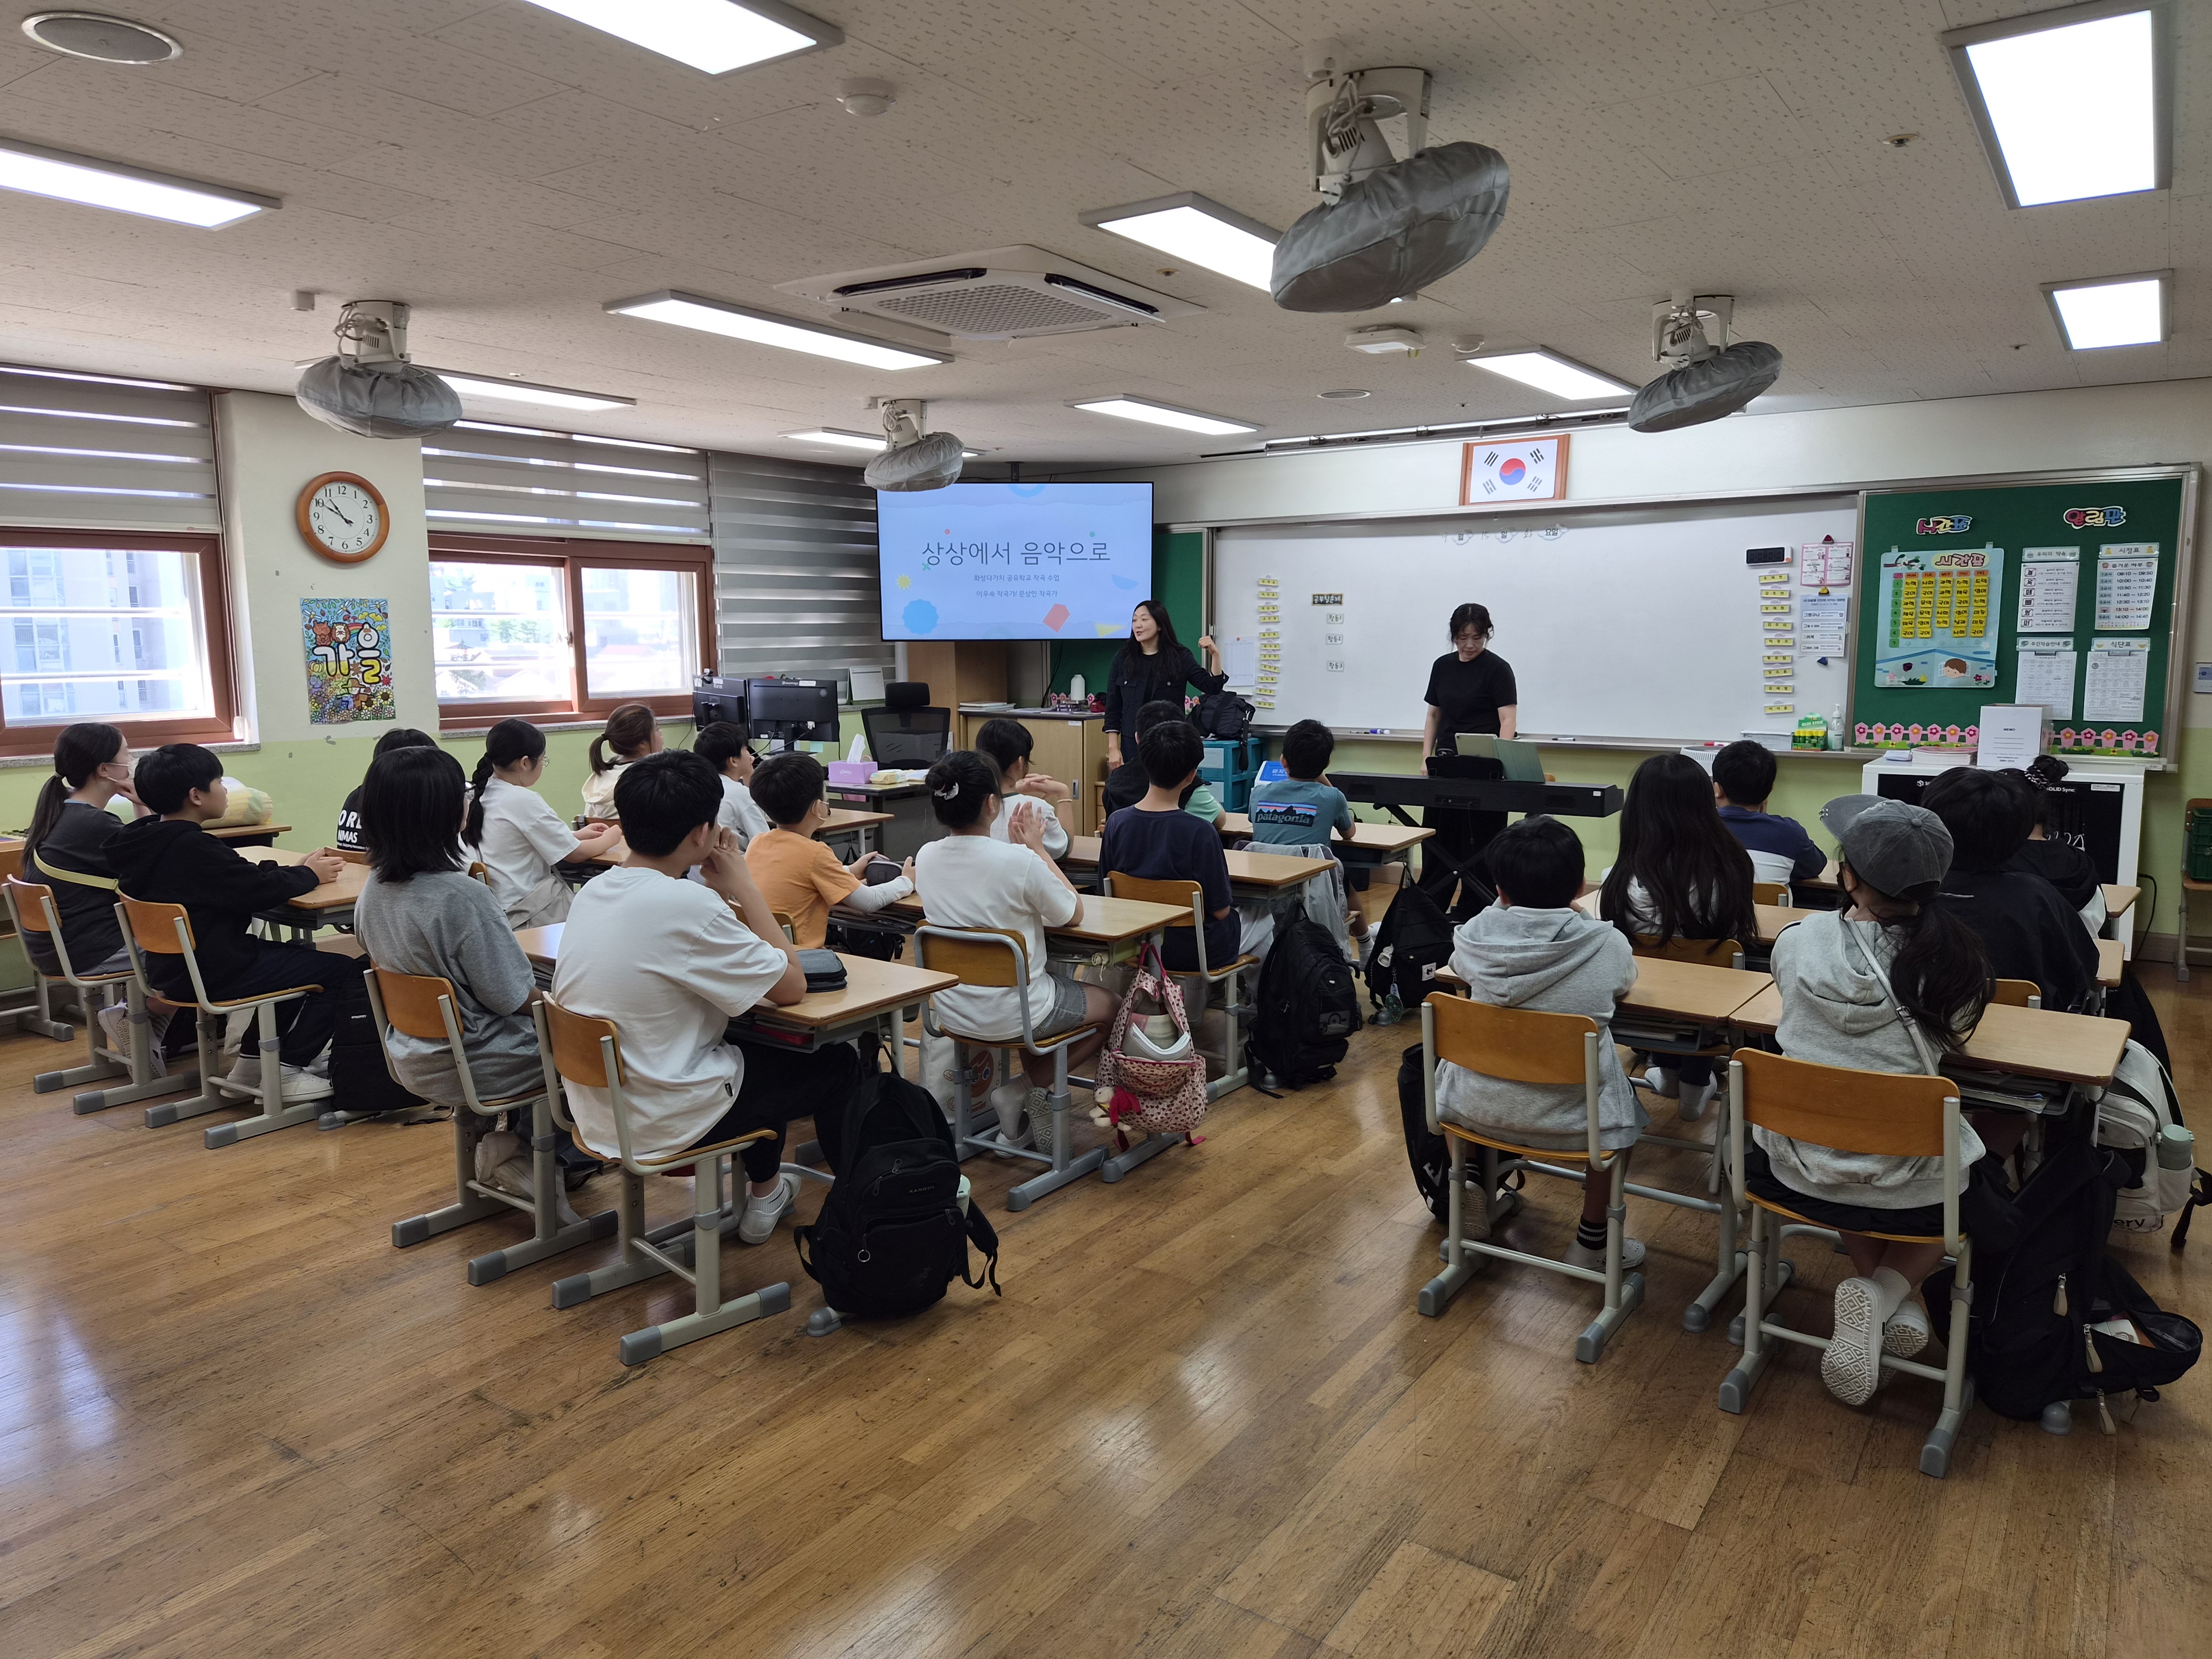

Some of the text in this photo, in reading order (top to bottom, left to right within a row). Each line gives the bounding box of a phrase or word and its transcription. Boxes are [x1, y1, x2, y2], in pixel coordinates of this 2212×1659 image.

[325, 488, 331, 497] 11
[338, 486, 347, 494] 12
[315, 498, 324, 508] 10
[363, 500, 368, 509] 2
[314, 512, 320, 521] 9
[367, 514, 373, 524] 3
[2066, 508, 2124, 527] 알림판
[317, 525, 325, 534] 8
[1917, 517, 1970, 534] 시간표
[363, 528, 369, 536] 4
[1481, 531, 1489, 540] 15
[1524, 528, 1533, 538] 화
[328, 536, 334, 545] 7
[342, 540, 348, 549] 6
[356, 538, 362, 546] 5
[922, 542, 1111, 565] 상상에서 음악으로
[312, 622, 382, 684] 가을
[1257, 813, 1310, 823] patagonia
[909, 1185, 935, 1193] KANGOL
